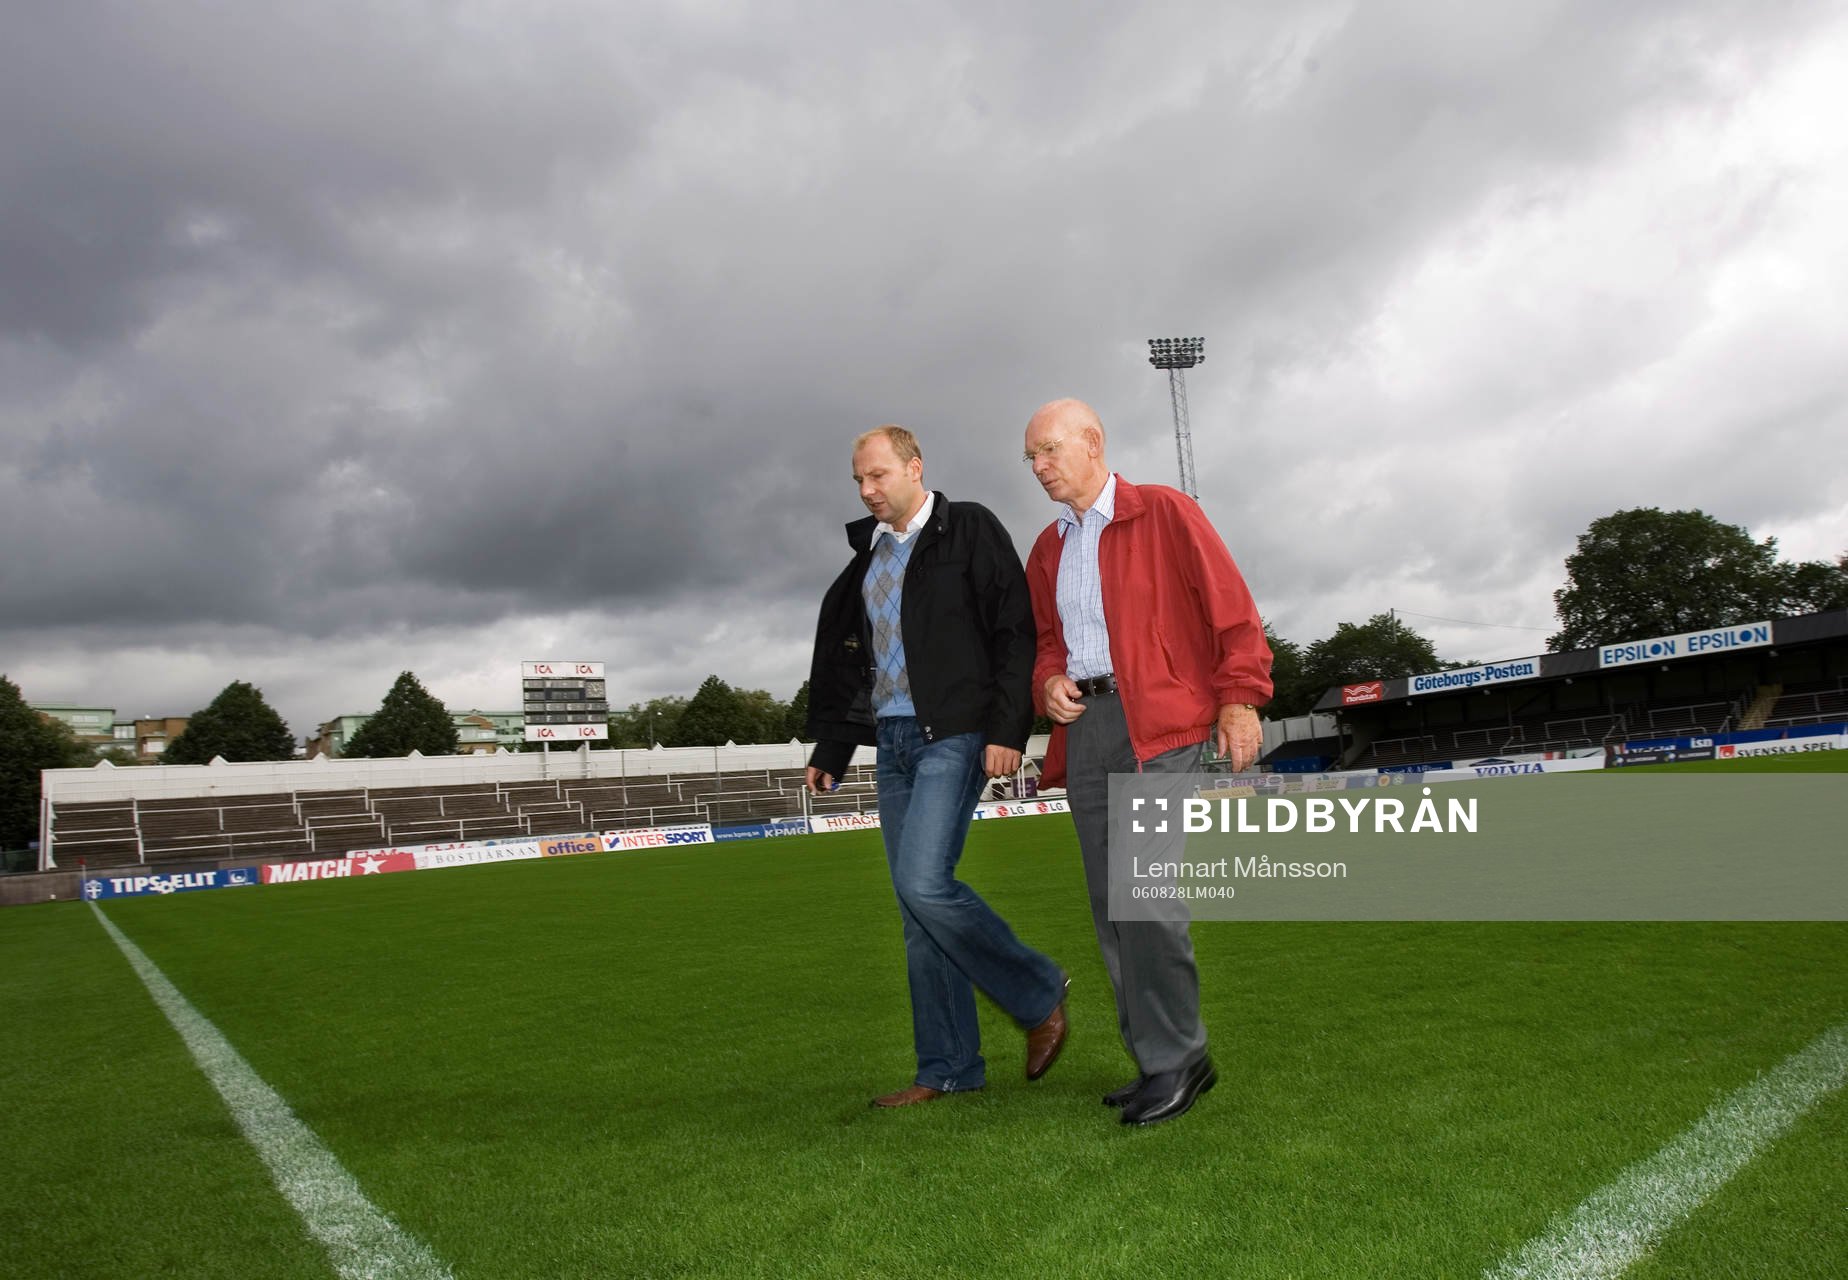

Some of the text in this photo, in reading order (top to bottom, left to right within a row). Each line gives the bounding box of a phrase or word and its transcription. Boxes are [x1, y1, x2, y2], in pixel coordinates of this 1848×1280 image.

[1603, 626, 1768, 665] EPSILON EPSILON
[534, 665, 593, 674] ICA ICA
[1414, 662, 1534, 692] Göteborgs-Posten
[538, 727, 597, 737] ICA ICA
[1737, 741, 1835, 758] SVENSKA SPEL
[1474, 762, 1546, 778] VOLVIA
[1009, 805, 1026, 816] LG
[1050, 802, 1065, 812] LG
[826, 815, 881, 828] HITACH
[622, 831, 707, 848] INTERSPORT
[764, 826, 808, 839] KPMG
[547, 841, 596, 855] office
[268, 859, 353, 884] MATCH
